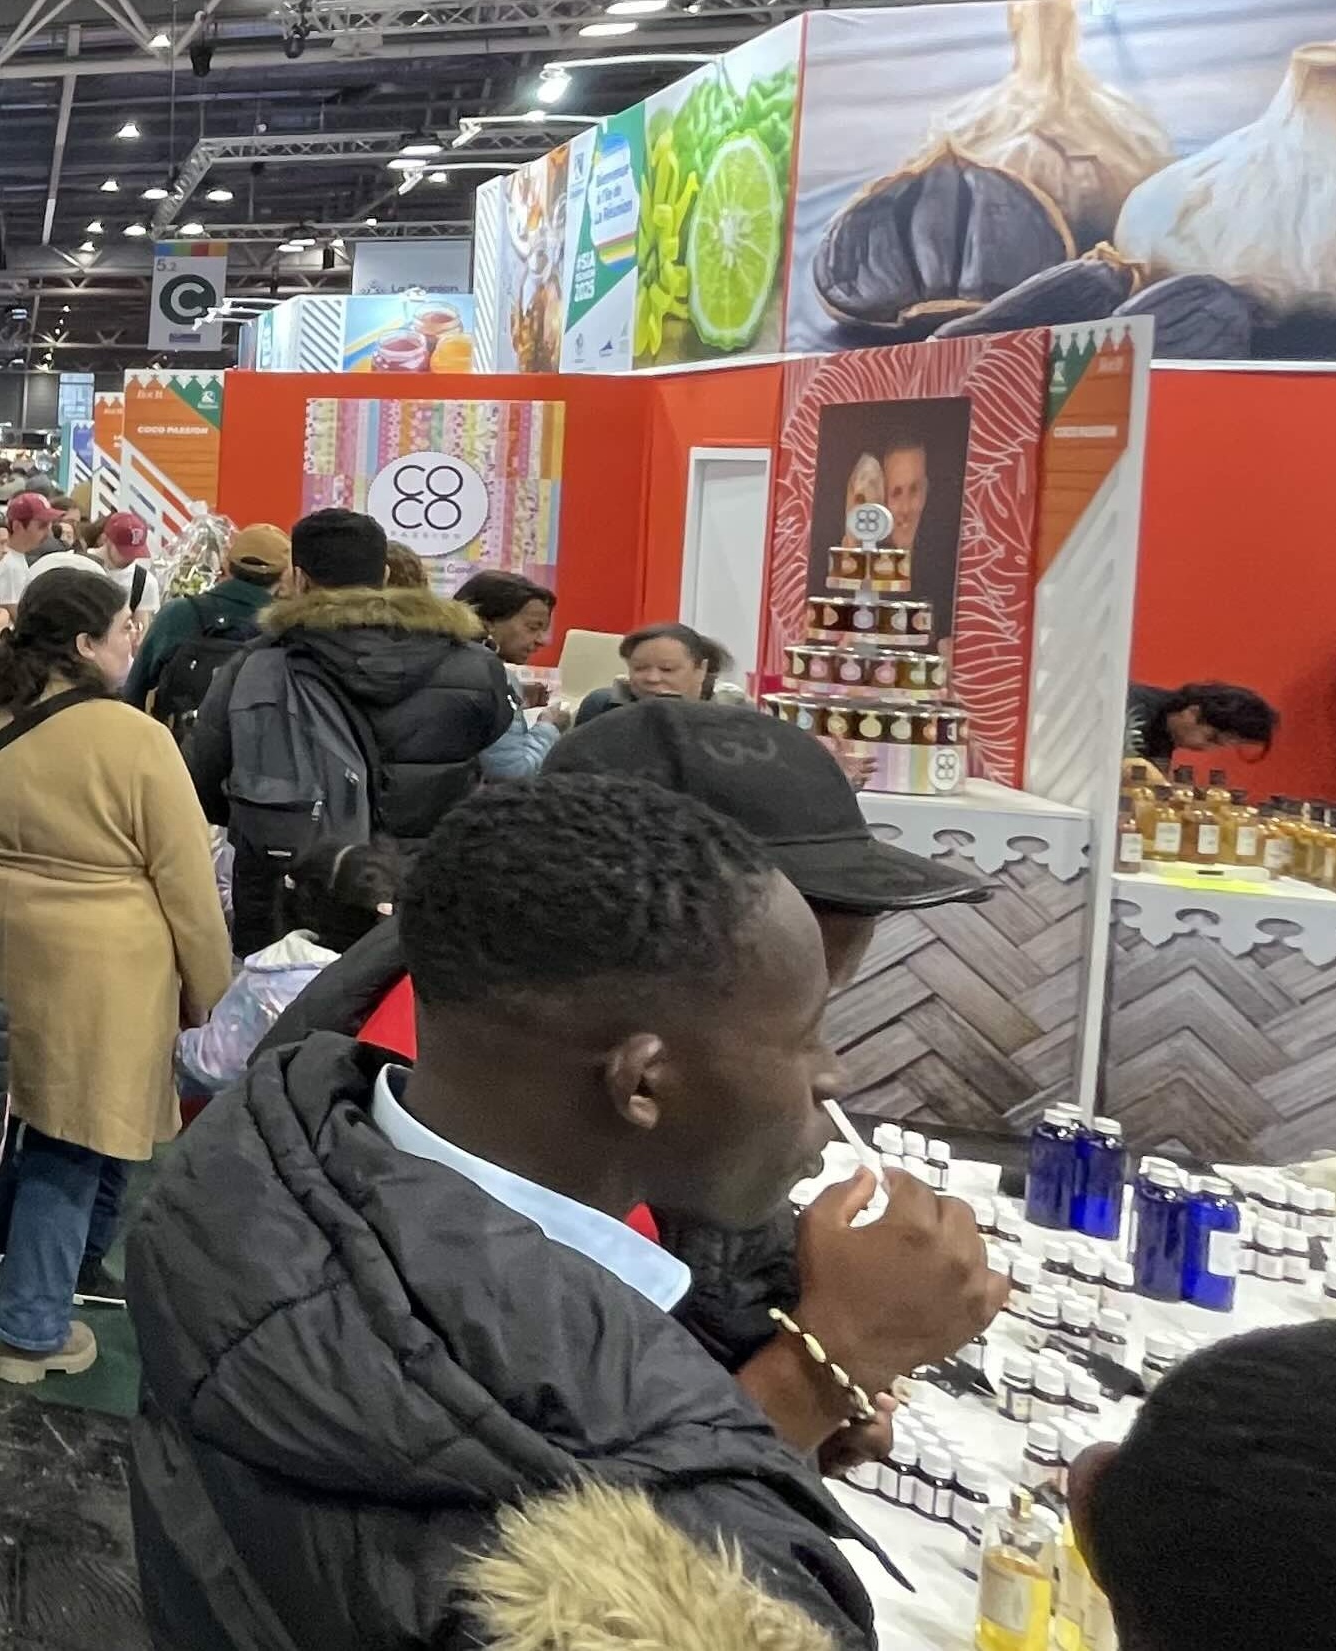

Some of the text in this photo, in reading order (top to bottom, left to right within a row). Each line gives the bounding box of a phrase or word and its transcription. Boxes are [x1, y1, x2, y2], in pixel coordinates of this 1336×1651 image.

[170, 282, 205, 317] C
[137, 426, 209, 434] COCO PASSION
